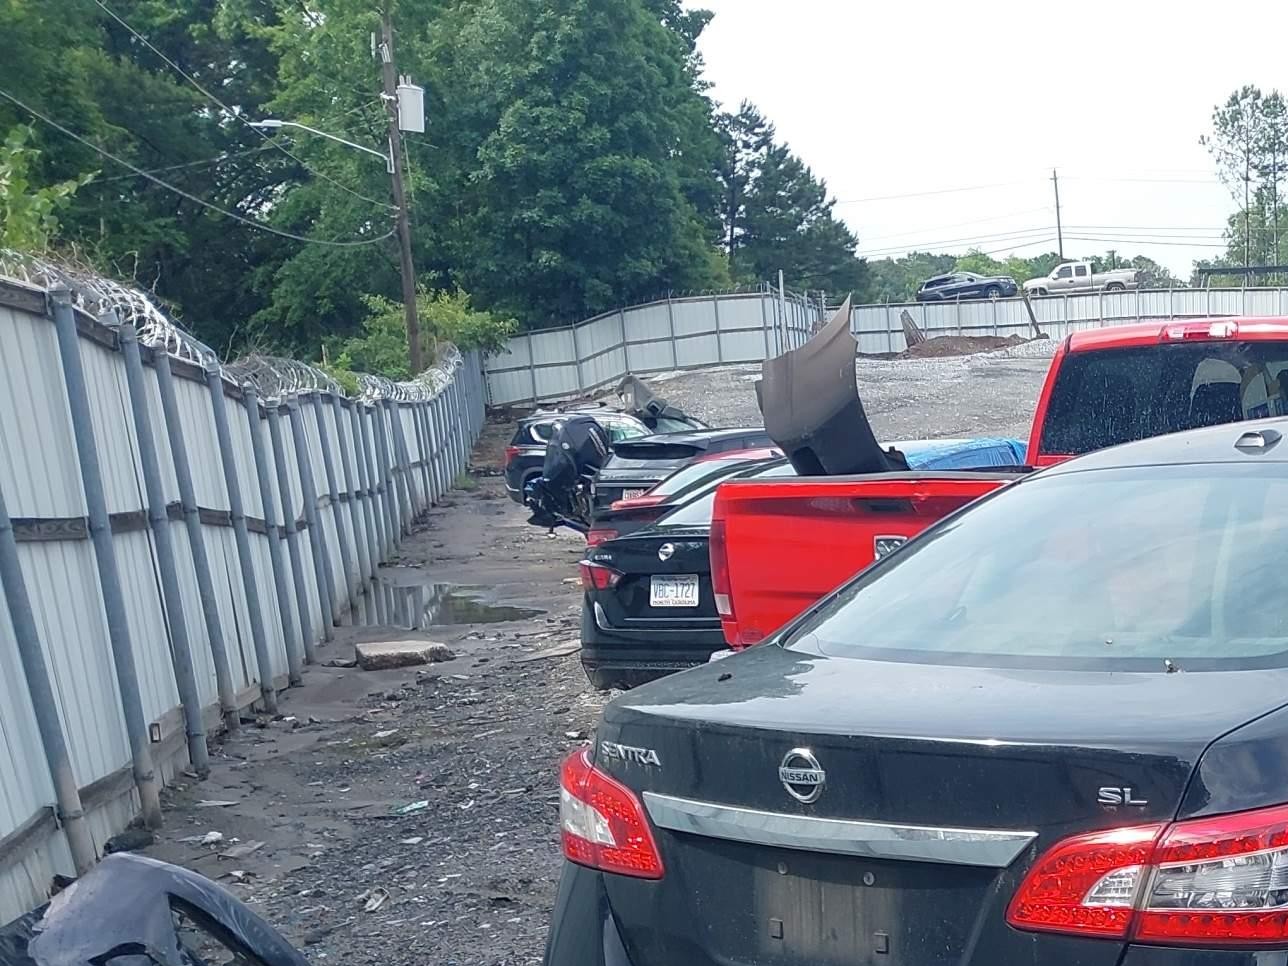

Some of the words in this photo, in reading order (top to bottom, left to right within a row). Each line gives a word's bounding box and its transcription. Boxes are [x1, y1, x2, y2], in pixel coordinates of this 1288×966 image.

[653, 582, 696, 599] VBC-1727
[601, 740, 661, 766] SENTRA
[781, 771, 818, 782] NISSAN
[1098, 787, 1148, 805] SL
